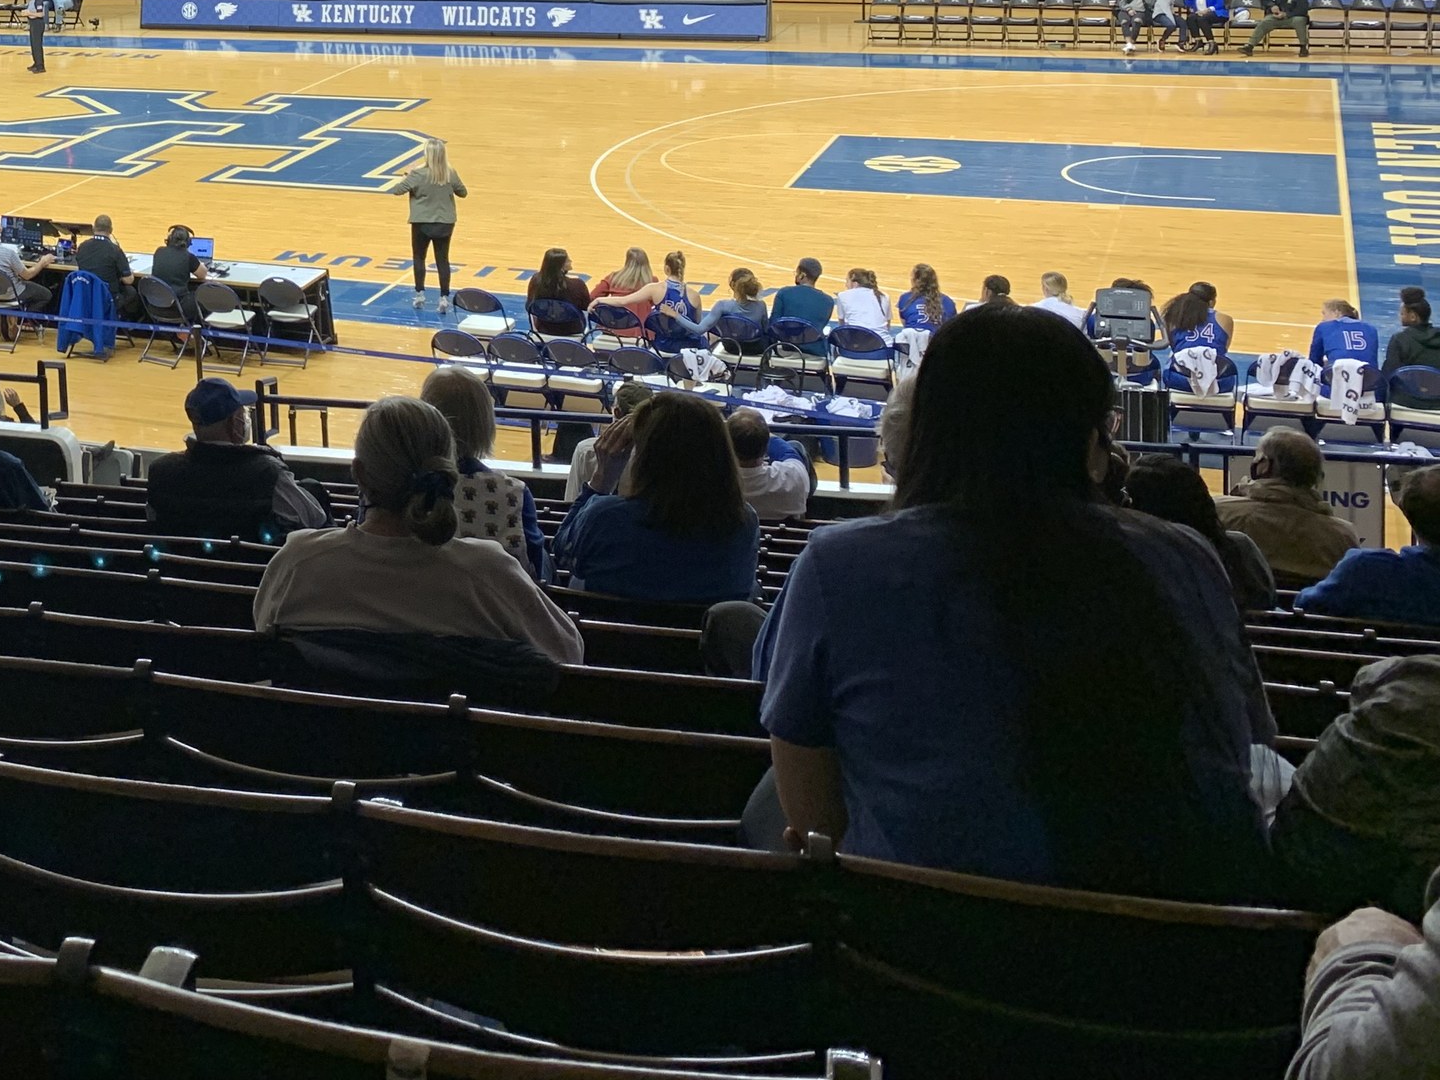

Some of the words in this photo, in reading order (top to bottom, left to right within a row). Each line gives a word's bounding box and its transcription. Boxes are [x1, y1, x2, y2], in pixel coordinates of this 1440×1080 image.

[182, 3, 198, 19] SEC
[292, 3, 312, 23] UK
[321, 4, 415, 24] KENTUCKY
[442, 5, 536, 27] WILDCATS
[639, 8, 665, 29] UK
[1342, 331, 1368, 350] 15
